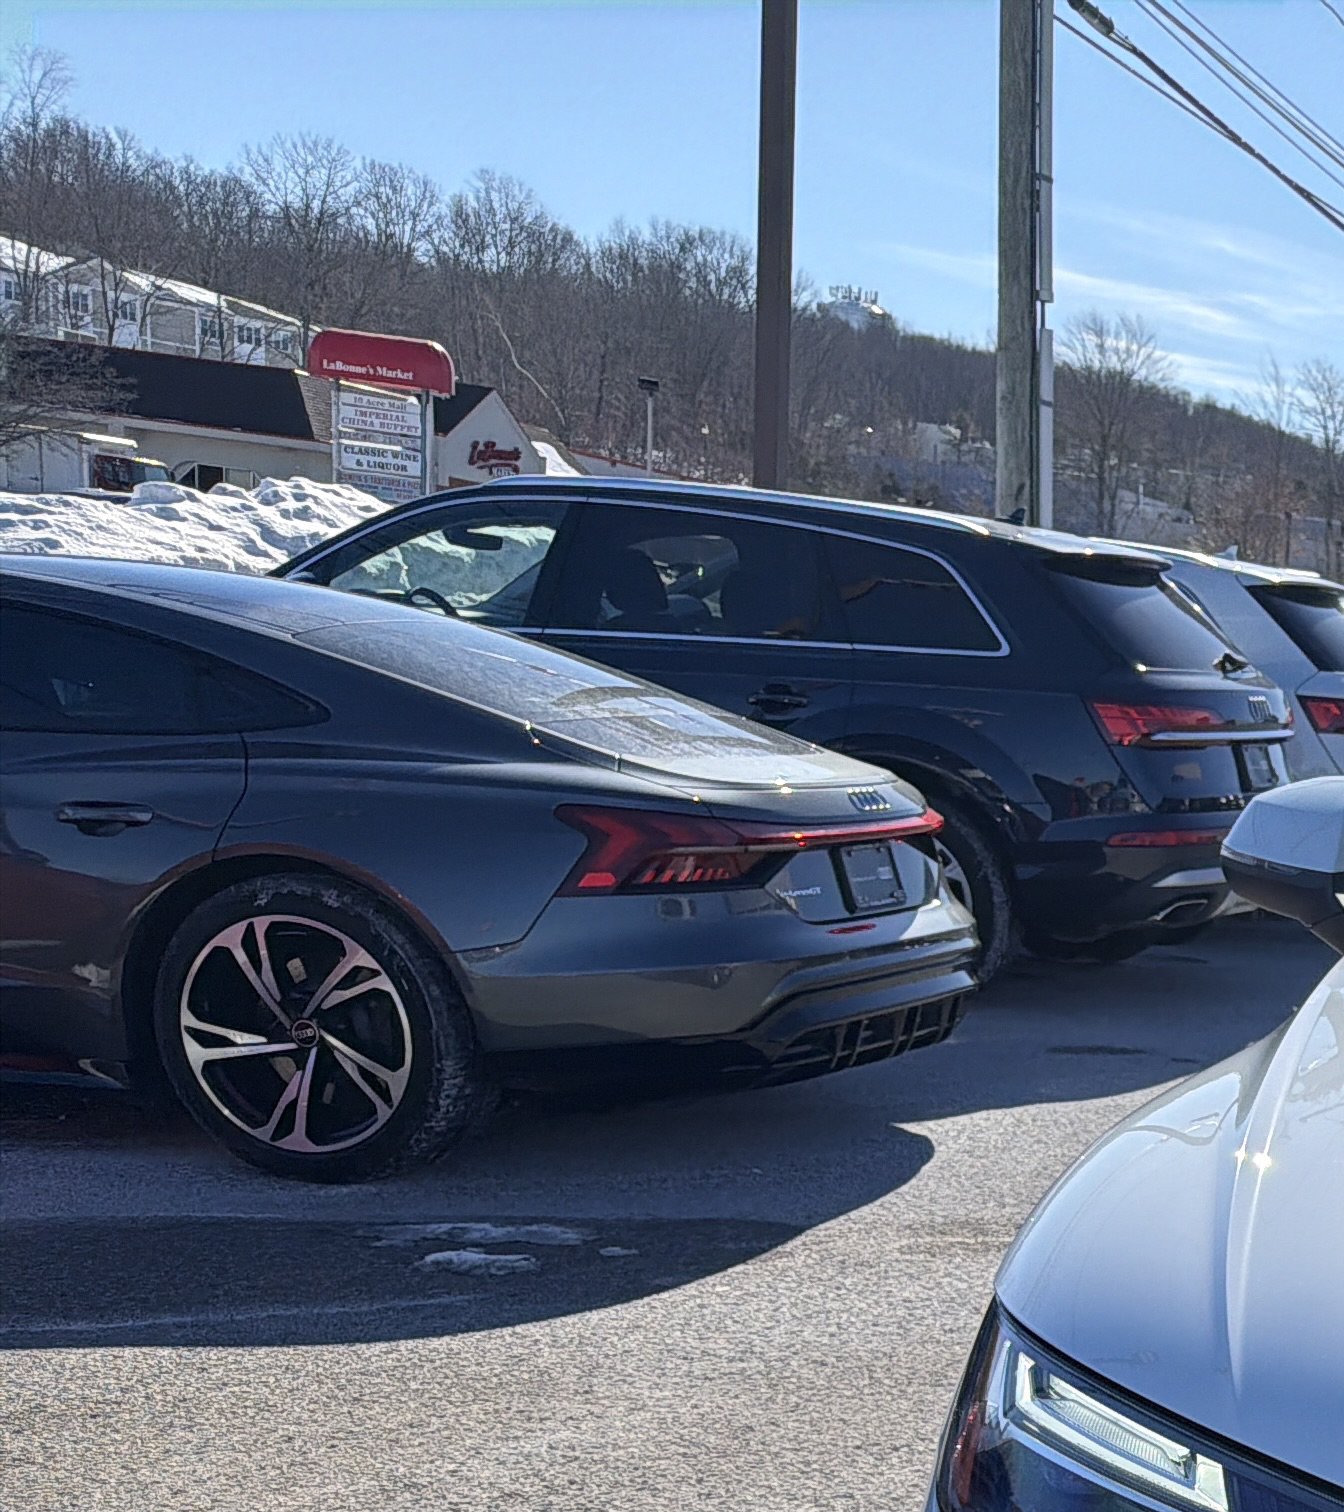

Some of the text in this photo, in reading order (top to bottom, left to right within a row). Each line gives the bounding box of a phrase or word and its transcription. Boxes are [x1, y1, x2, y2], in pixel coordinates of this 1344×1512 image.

[323, 359, 414, 380] LaBonne's Market
[366, 399, 386, 407] Acre
[388, 401, 406, 411] Mall
[354, 409, 407, 423] IMPERIAL
[341, 416, 420, 434] CHINA BUFFET
[343, 446, 419, 462] CLASSIC WINE
[355, 458, 408, 473] & LIQUOR
